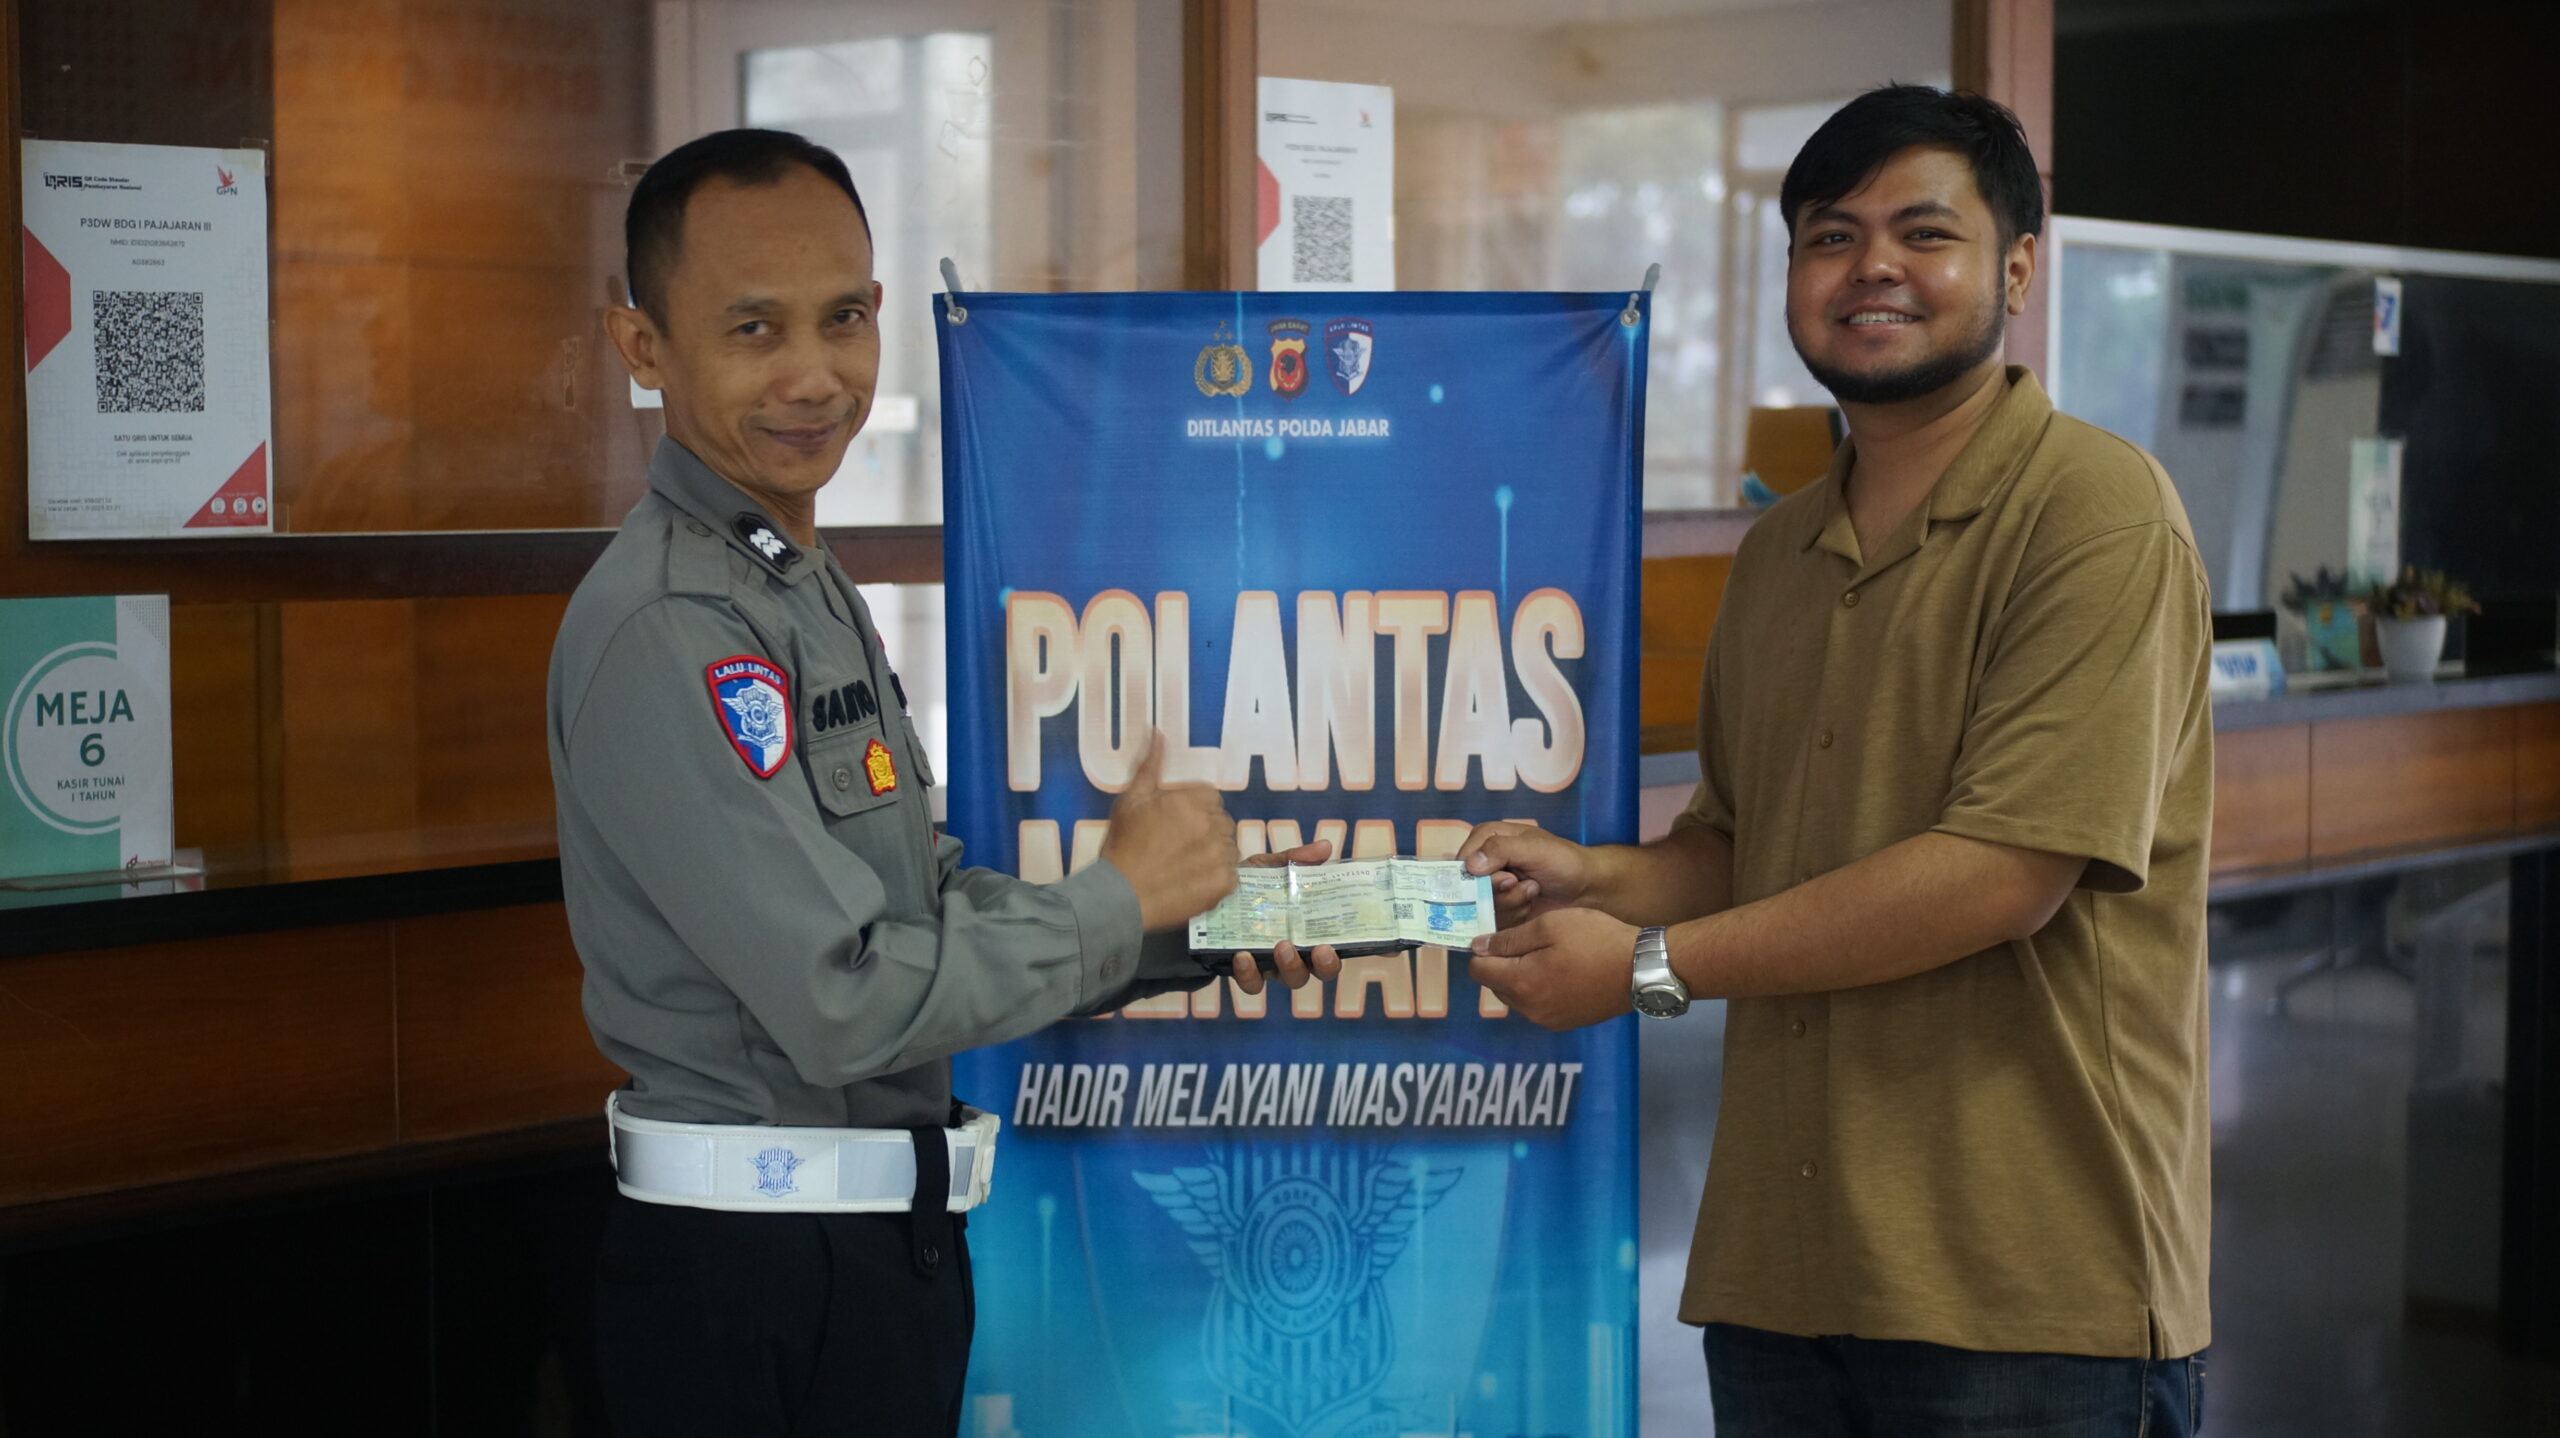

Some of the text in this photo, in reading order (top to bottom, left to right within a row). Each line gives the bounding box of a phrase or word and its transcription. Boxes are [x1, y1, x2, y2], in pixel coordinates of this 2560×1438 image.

[216, 186, 238, 196] GPN
[80, 217, 112, 229] P3DW
[114, 218, 137, 229] BDG
[144, 219, 202, 231] PAJAJARAN
[1187, 419, 1390, 437] DITLANTAS POLDA JABAR
[714, 662, 781, 685] LALU LINTAS
[1006, 587, 1585, 793] POLANTAS
[36, 689, 134, 727] MEJA
[79, 733, 105, 767] 6
[57, 776, 125, 790] KASIR TUNAI
[80, 791, 116, 802] TAHUN
[1012, 1063, 1583, 1127] HADIR MELAYANI MASYARAKAT
